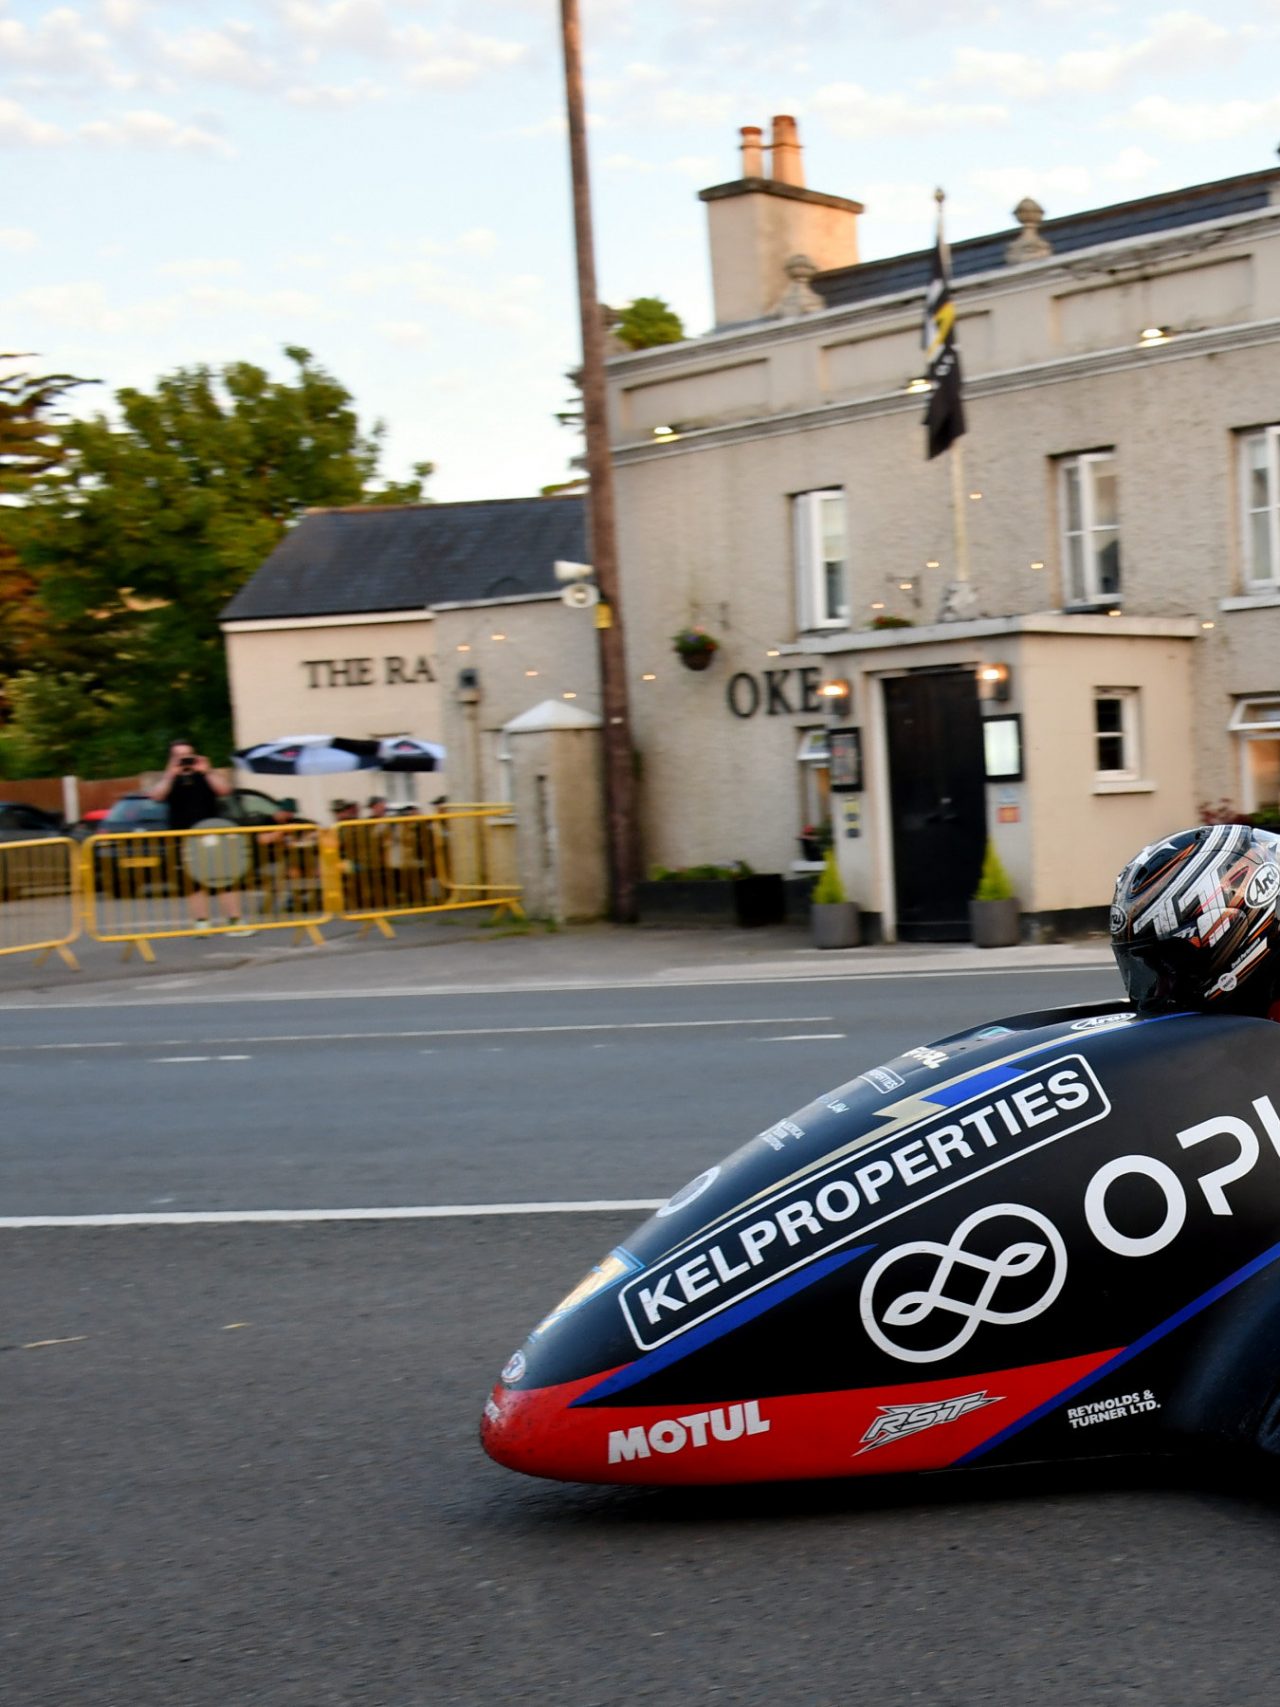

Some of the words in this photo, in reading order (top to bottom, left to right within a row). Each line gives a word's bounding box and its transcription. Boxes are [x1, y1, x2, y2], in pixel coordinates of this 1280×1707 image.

[301, 657, 373, 689] THE
[385, 655, 437, 685] RA
[637, 1069, 1090, 1326] KELPROPERTIES
[862, 1394, 986, 1443] RST
[1066, 1392, 1141, 1420] REYNOLDS
[1142, 1389, 1155, 1401] &
[1068, 1406, 1128, 1429] TURNER
[1129, 1399, 1162, 1415] LTD.
[608, 1400, 771, 1465] MOTUL
